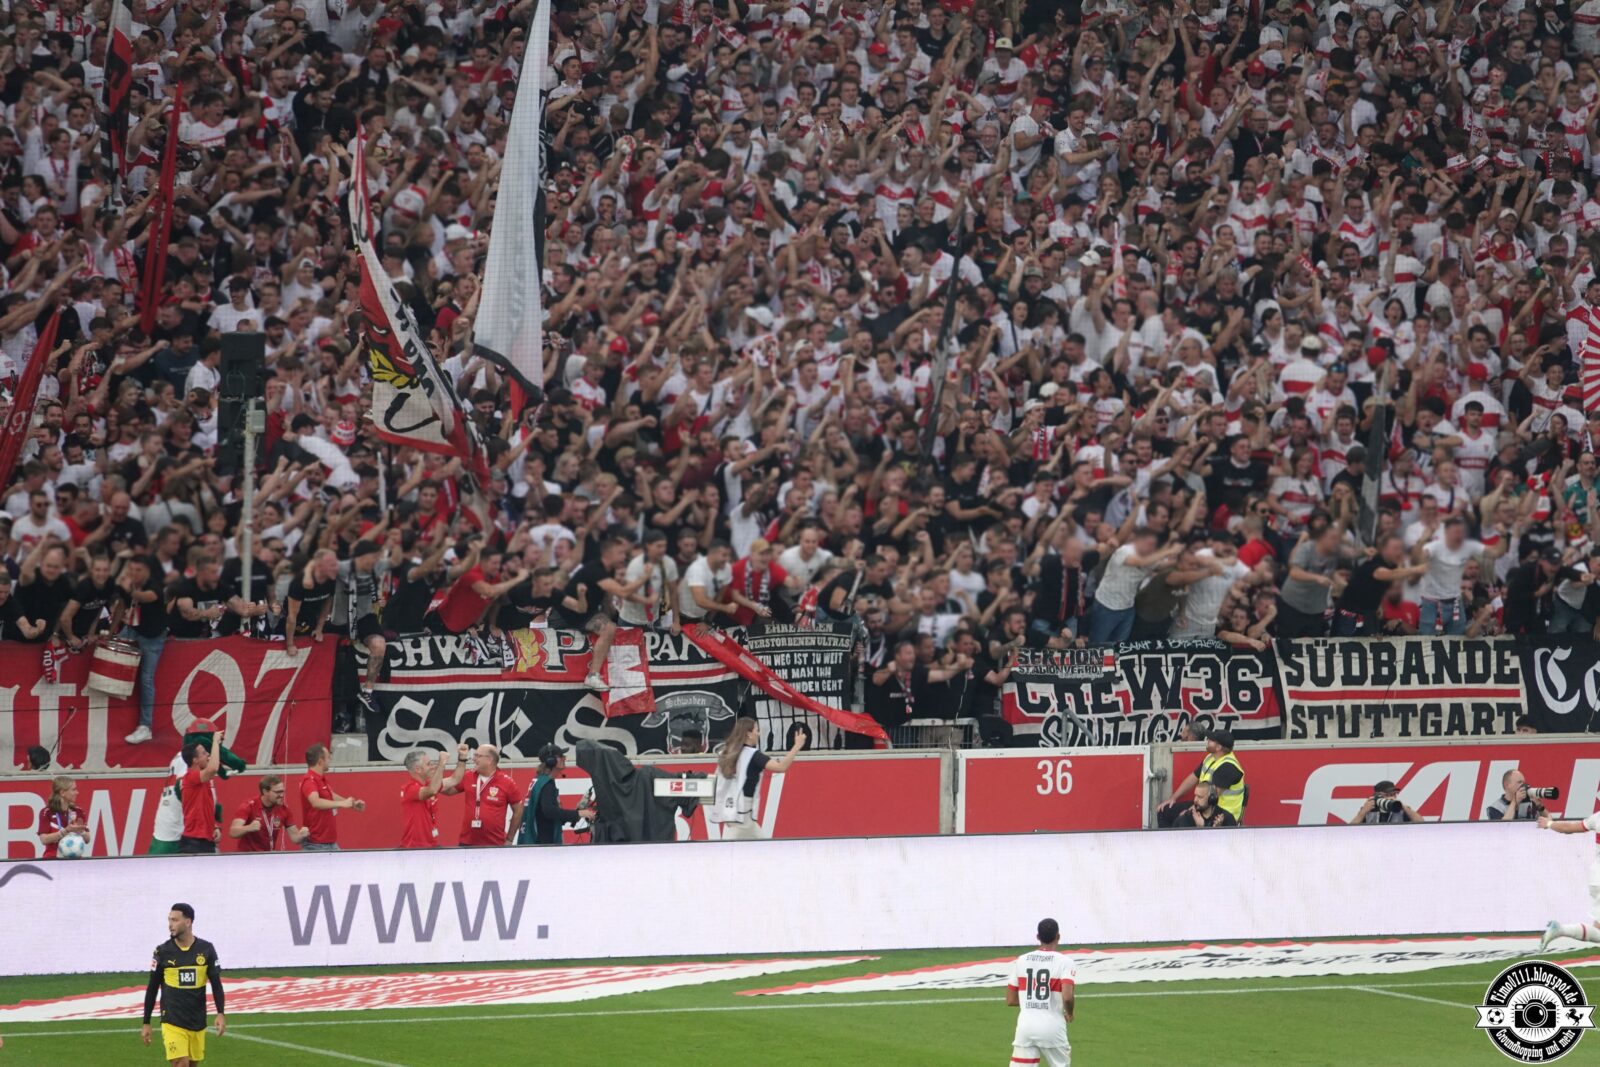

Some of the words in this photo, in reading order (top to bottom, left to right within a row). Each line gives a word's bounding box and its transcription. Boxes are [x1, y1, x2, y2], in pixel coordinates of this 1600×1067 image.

[748, 636, 816, 650] VERSTORBENEN
[817, 636, 851, 648] ULTRAS
[773, 653, 791, 666] WEG
[794, 652, 808, 665] IST
[812, 653, 822, 665] ZU
[823, 652, 844, 665] WEIT
[1283, 639, 1520, 688] SÜDBANDE
[791, 667, 814, 679] MAN
[821, 679, 844, 691] GEHT
[172, 648, 312, 767] 97
[1291, 703, 1523, 739] STUTTGART
[1036, 759, 1073, 795] 36
[180, 972, 195, 982] 1&1
[1026, 968, 1051, 1000] 18
